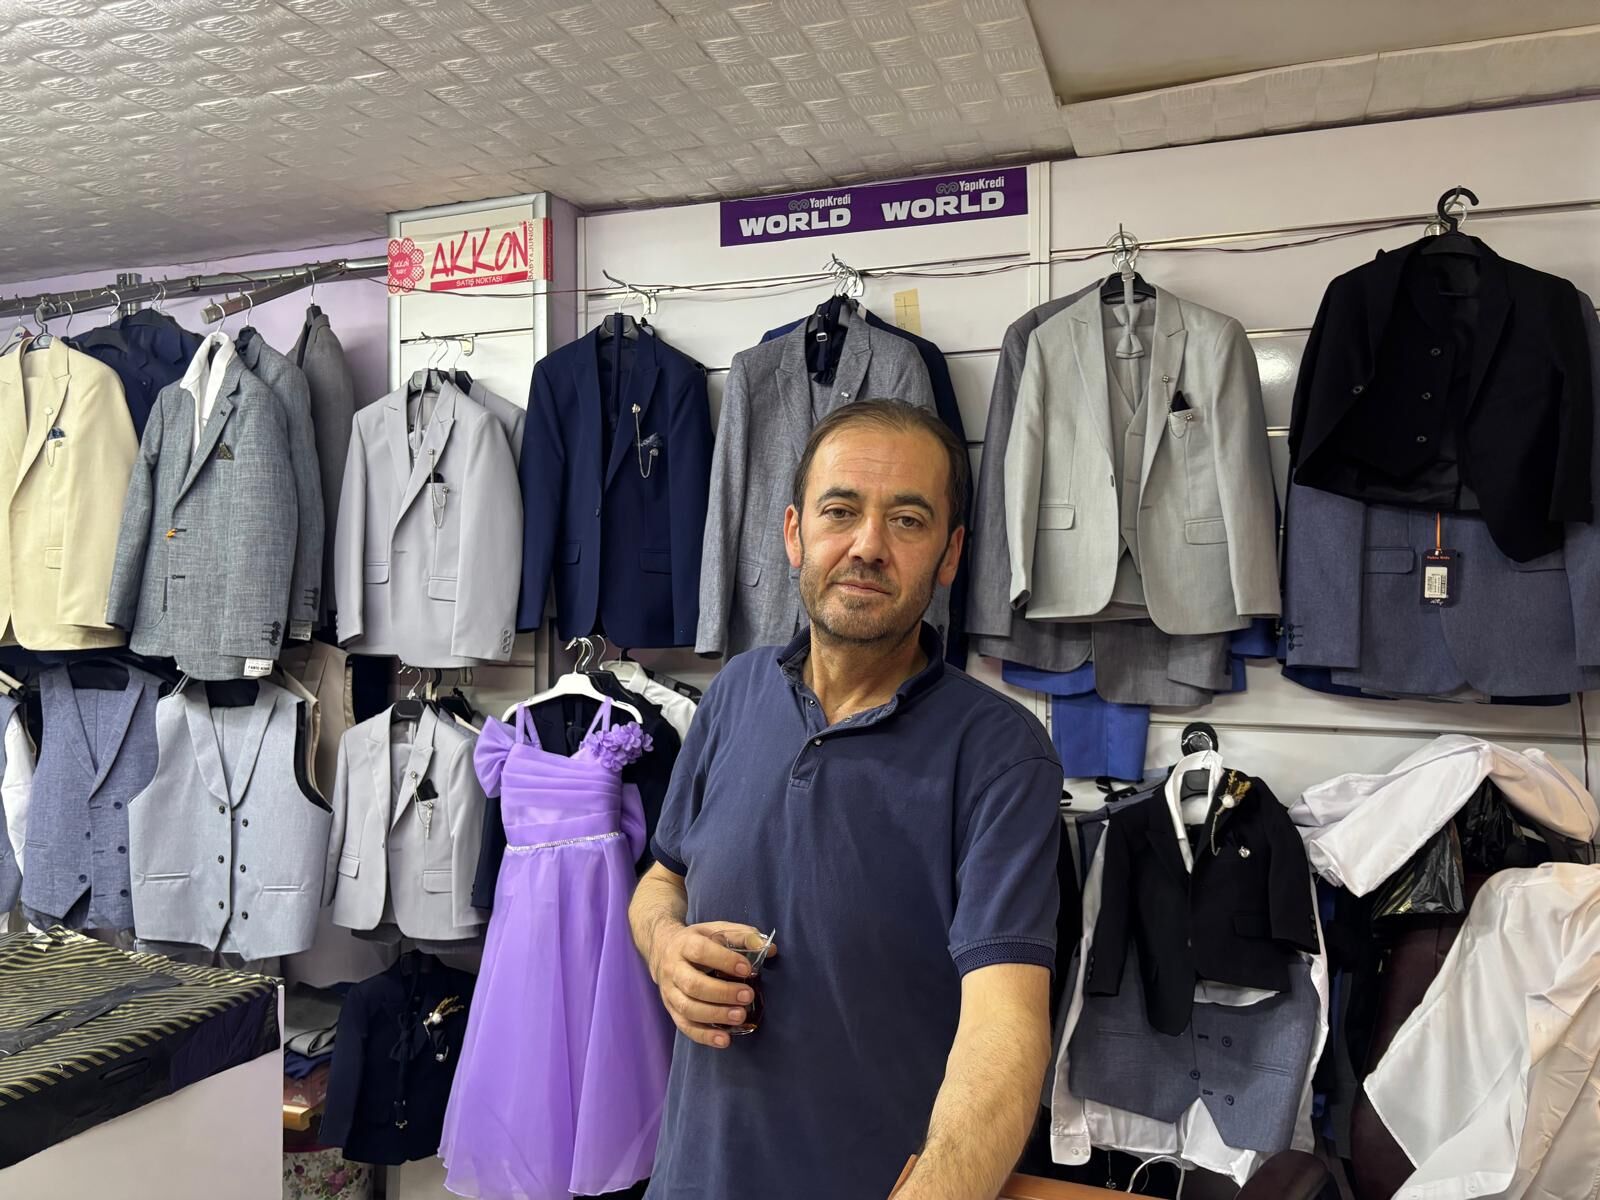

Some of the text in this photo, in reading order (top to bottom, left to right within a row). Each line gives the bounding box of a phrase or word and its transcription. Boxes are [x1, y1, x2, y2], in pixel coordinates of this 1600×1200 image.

[959, 176, 1005, 193] YapıKredi
[809, 193, 851, 209] YapıKredi
[881, 191, 1005, 222] WORLD
[739, 207, 851, 237] WORLD
[430, 220, 528, 279] AKKON
[455, 275, 503, 288] SATIŞ NOKTASI
